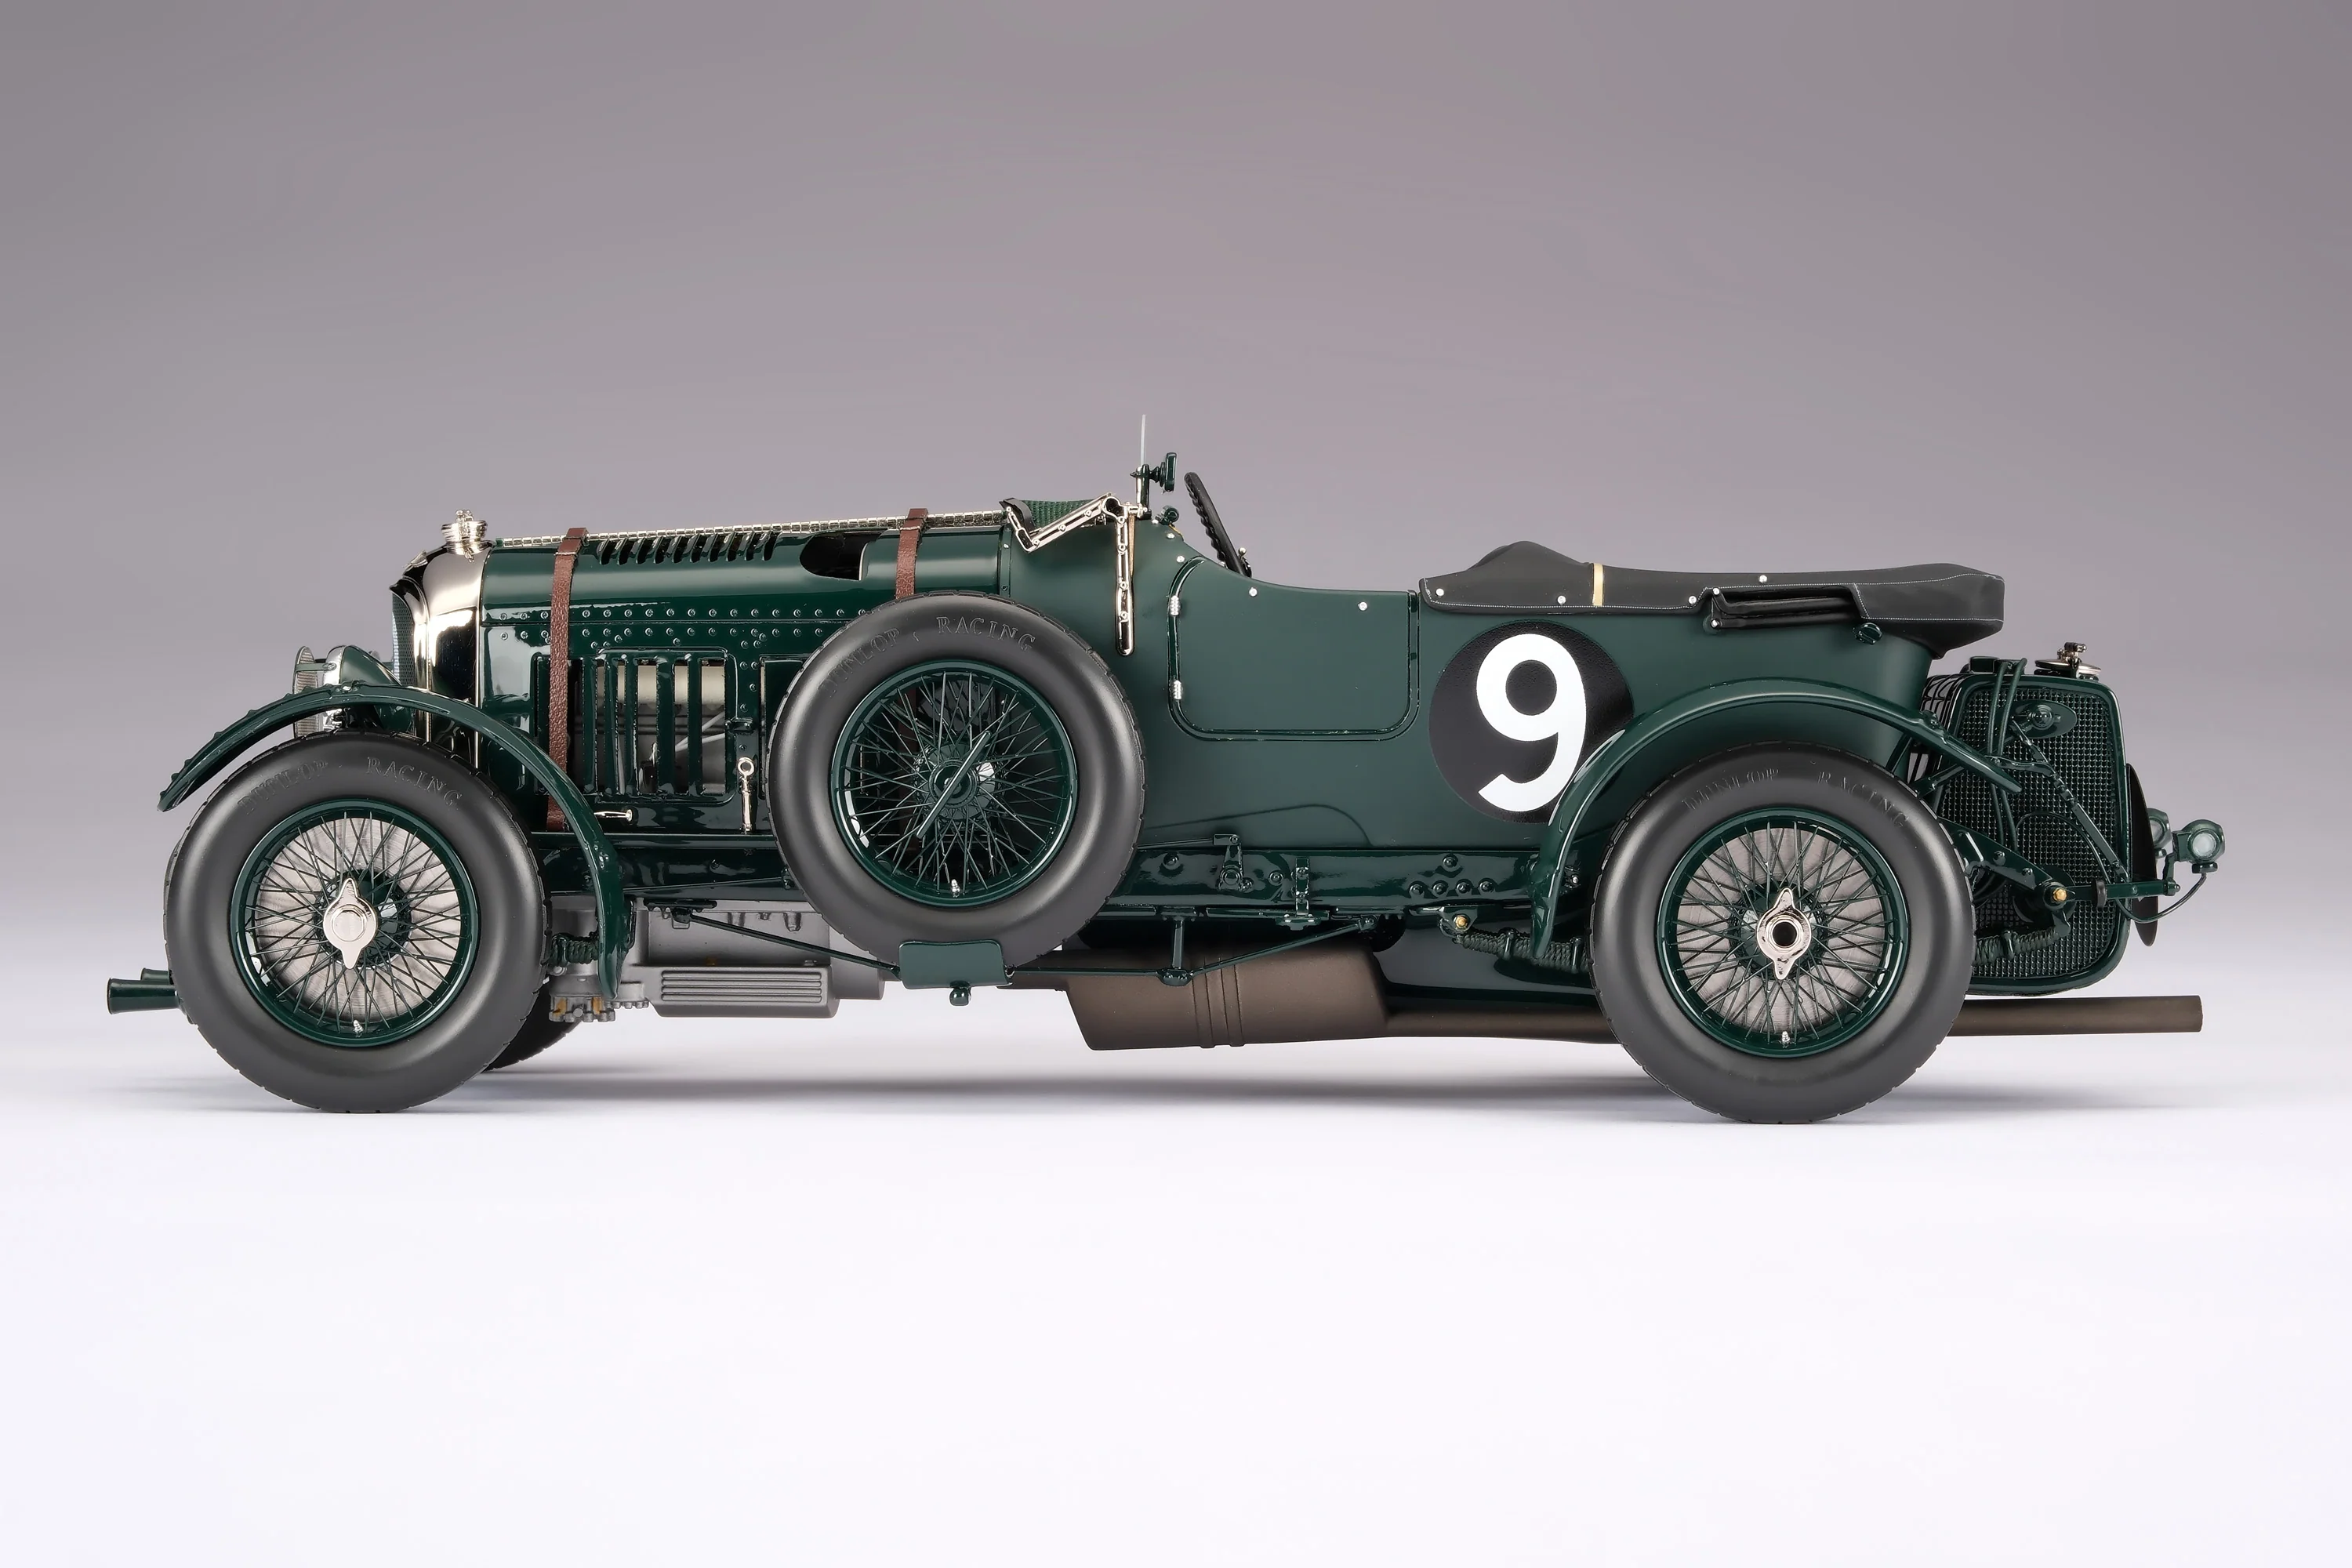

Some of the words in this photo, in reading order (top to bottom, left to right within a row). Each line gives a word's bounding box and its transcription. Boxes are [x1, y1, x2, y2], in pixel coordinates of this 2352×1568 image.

[936, 615, 1036, 652] RACING
[1476, 633, 1587, 812] 9
[365, 756, 463, 811] RACING
